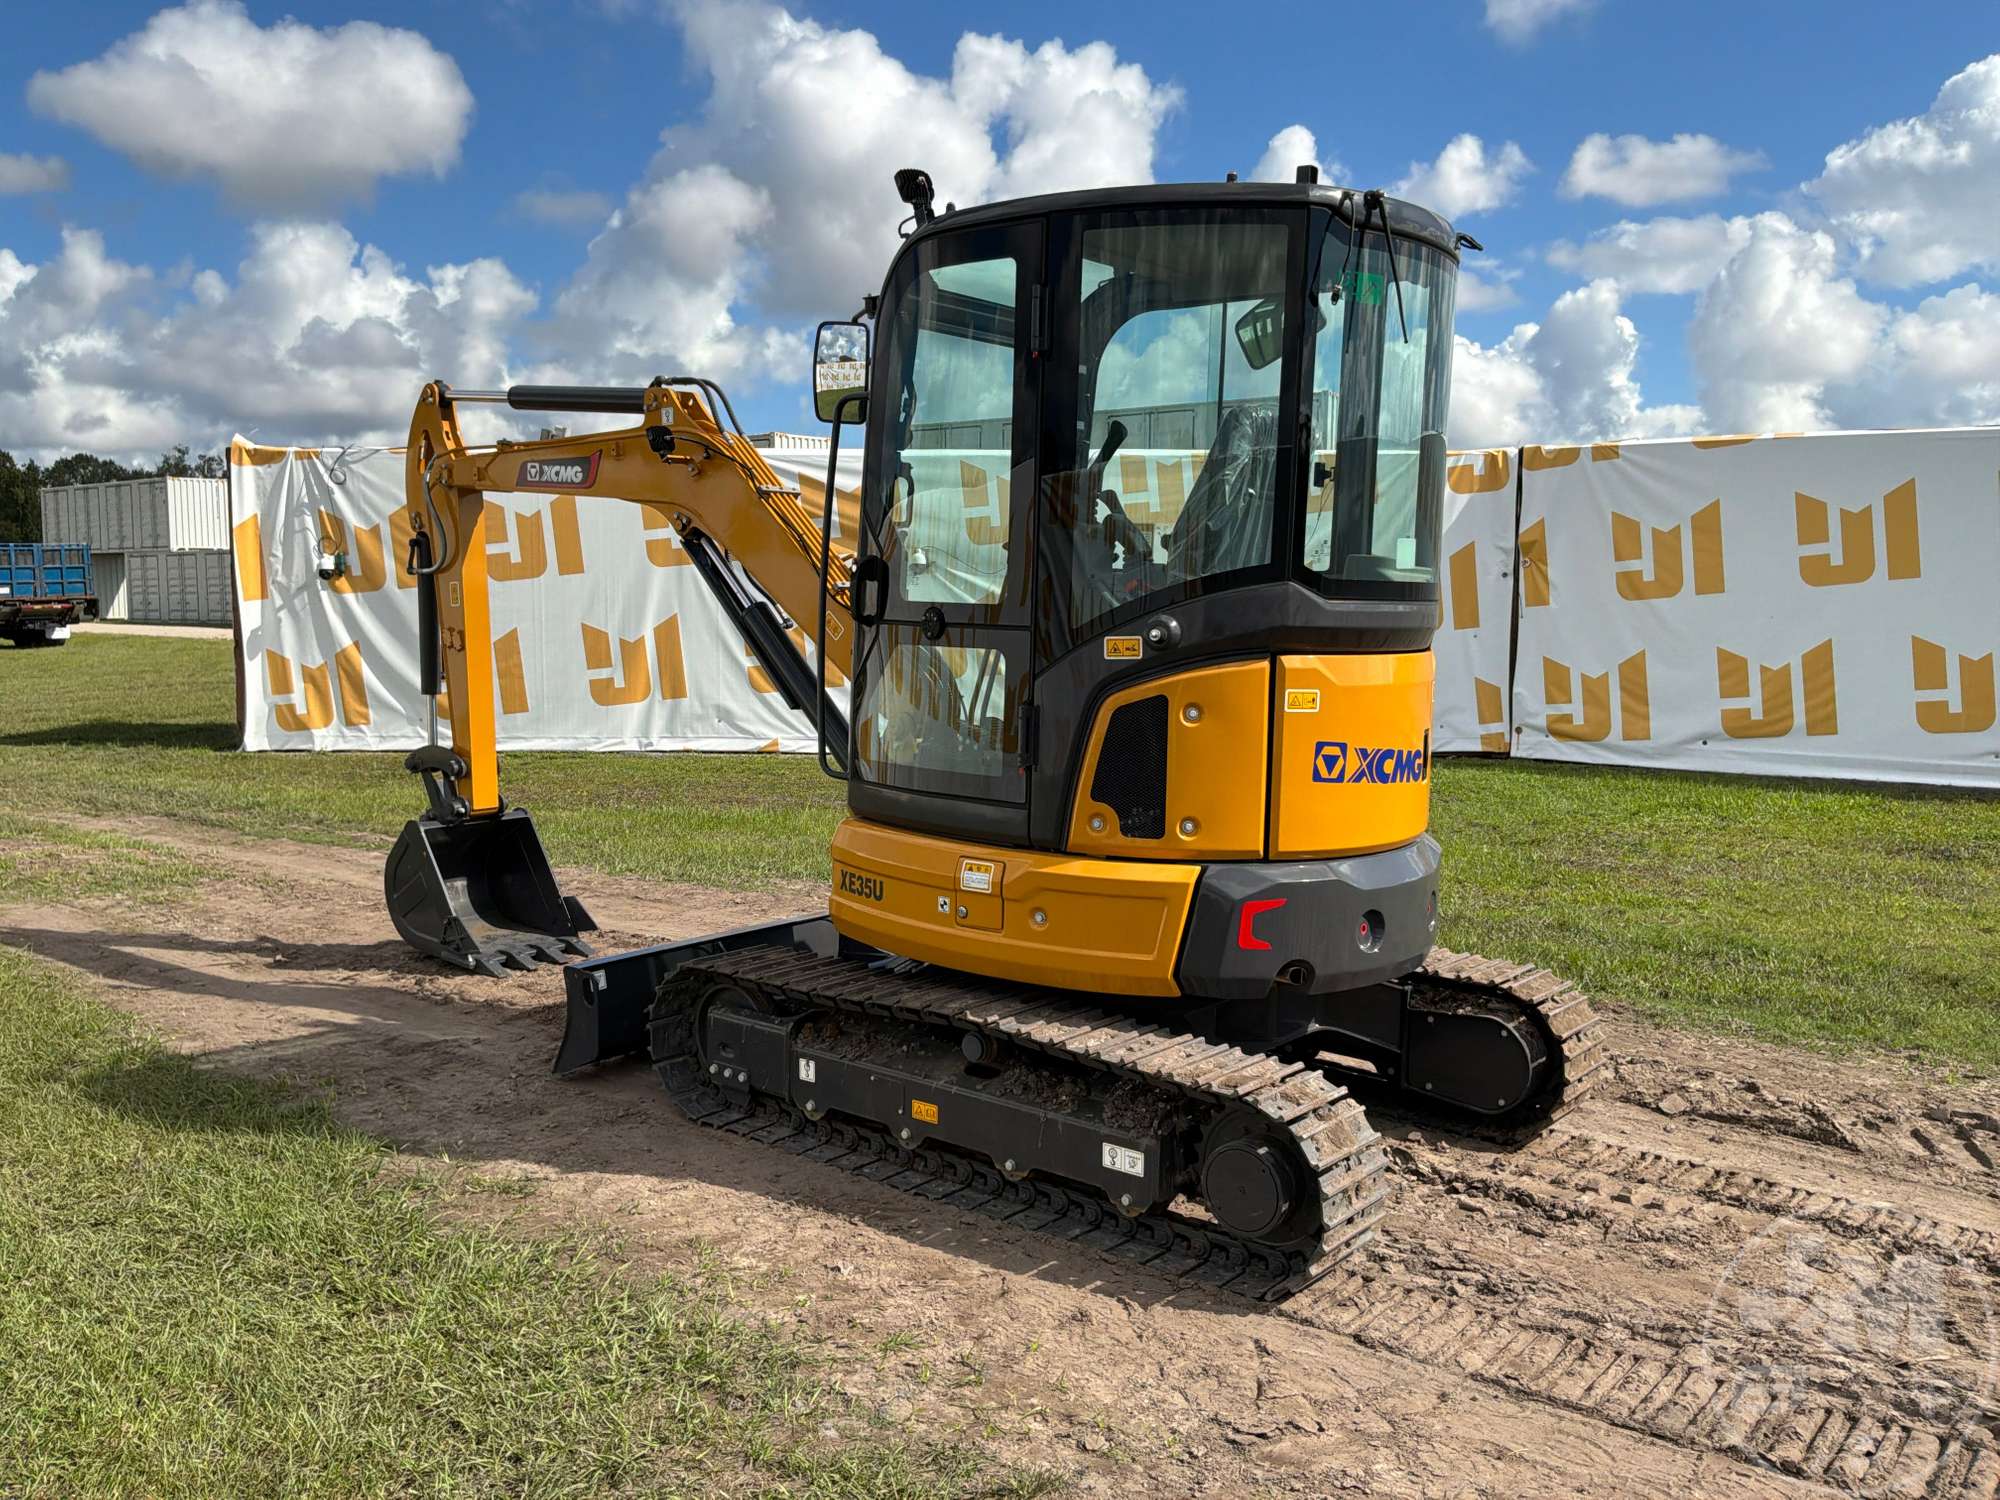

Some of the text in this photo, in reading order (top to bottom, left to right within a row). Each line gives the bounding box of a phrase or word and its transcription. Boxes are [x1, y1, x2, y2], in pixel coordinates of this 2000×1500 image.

[540, 465, 583, 483] XCMG
[1347, 747, 1424, 784] XCMG
[840, 869, 884, 901] XE35U
